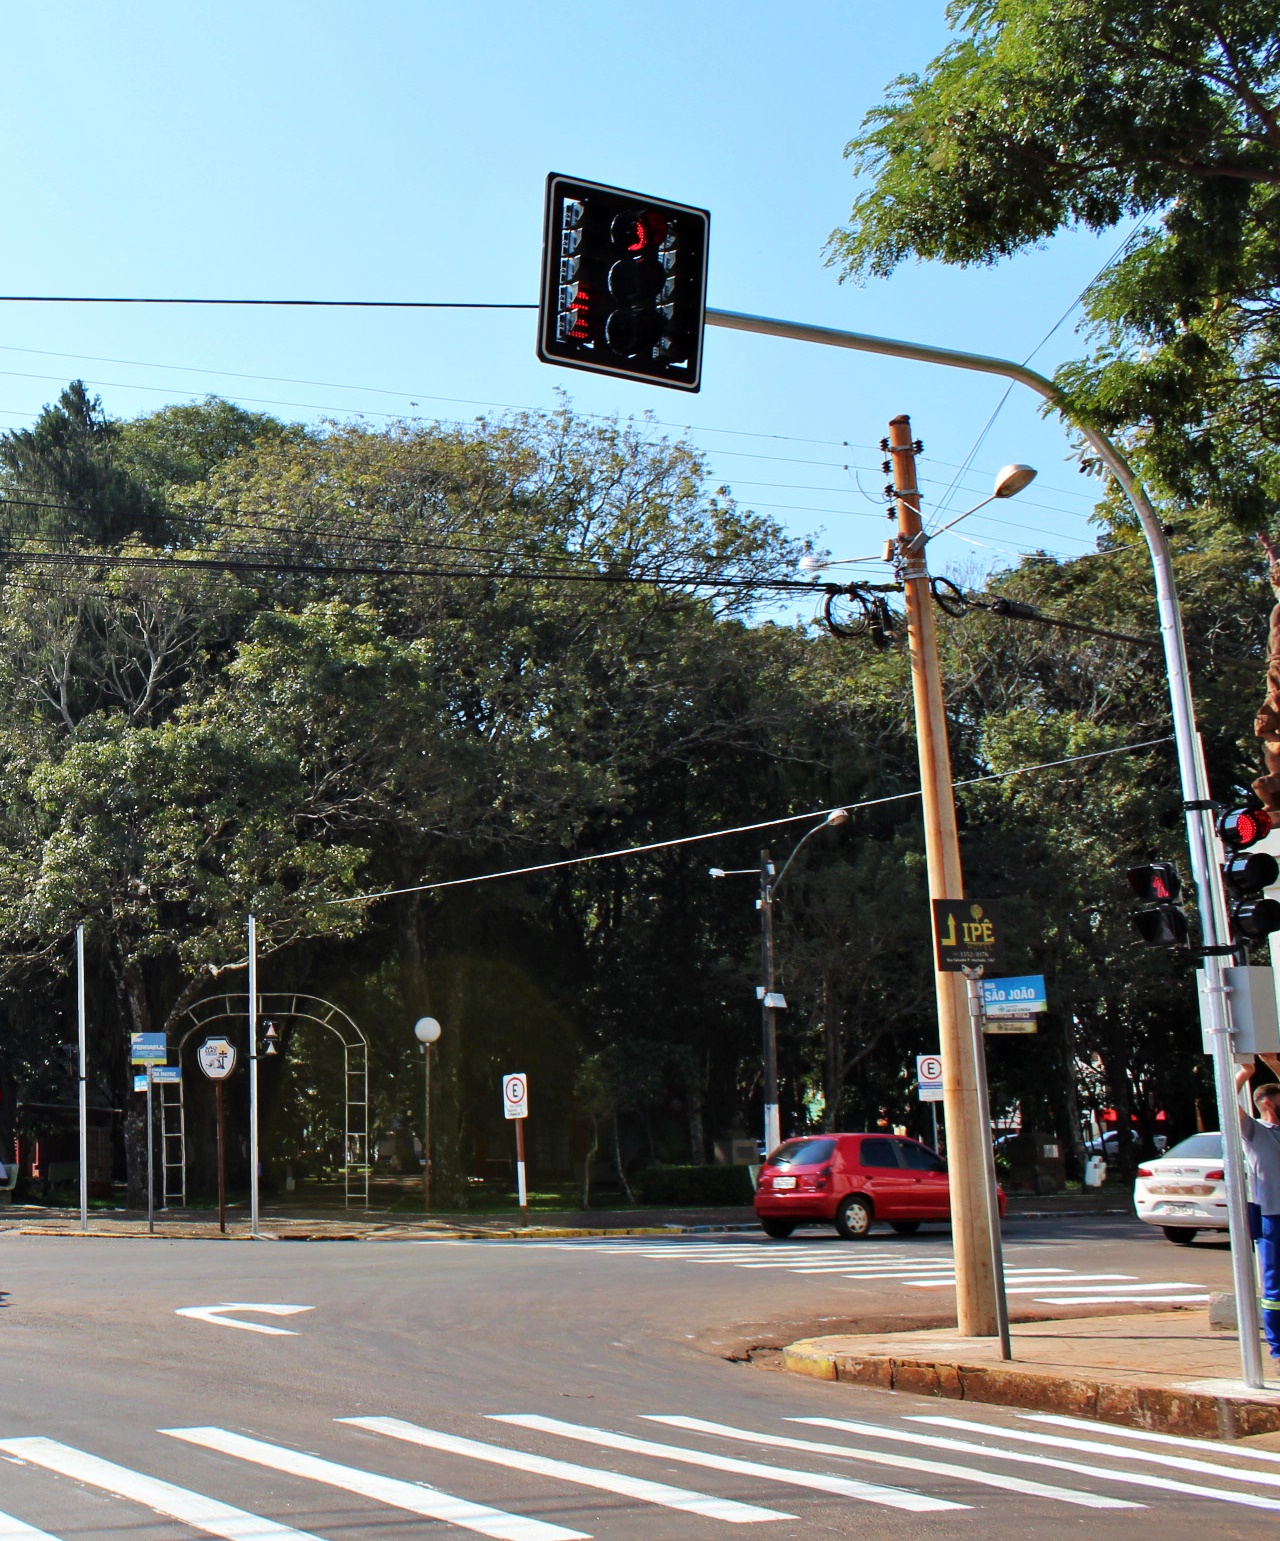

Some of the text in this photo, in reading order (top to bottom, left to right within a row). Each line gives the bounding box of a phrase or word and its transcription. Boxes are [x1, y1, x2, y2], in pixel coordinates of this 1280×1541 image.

[962, 918, 996, 942] IPÊ
[985, 986, 1036, 1002] SÃO JOÃO
[927, 1062, 936, 1075] E
[512, 1083, 519, 1098] E
